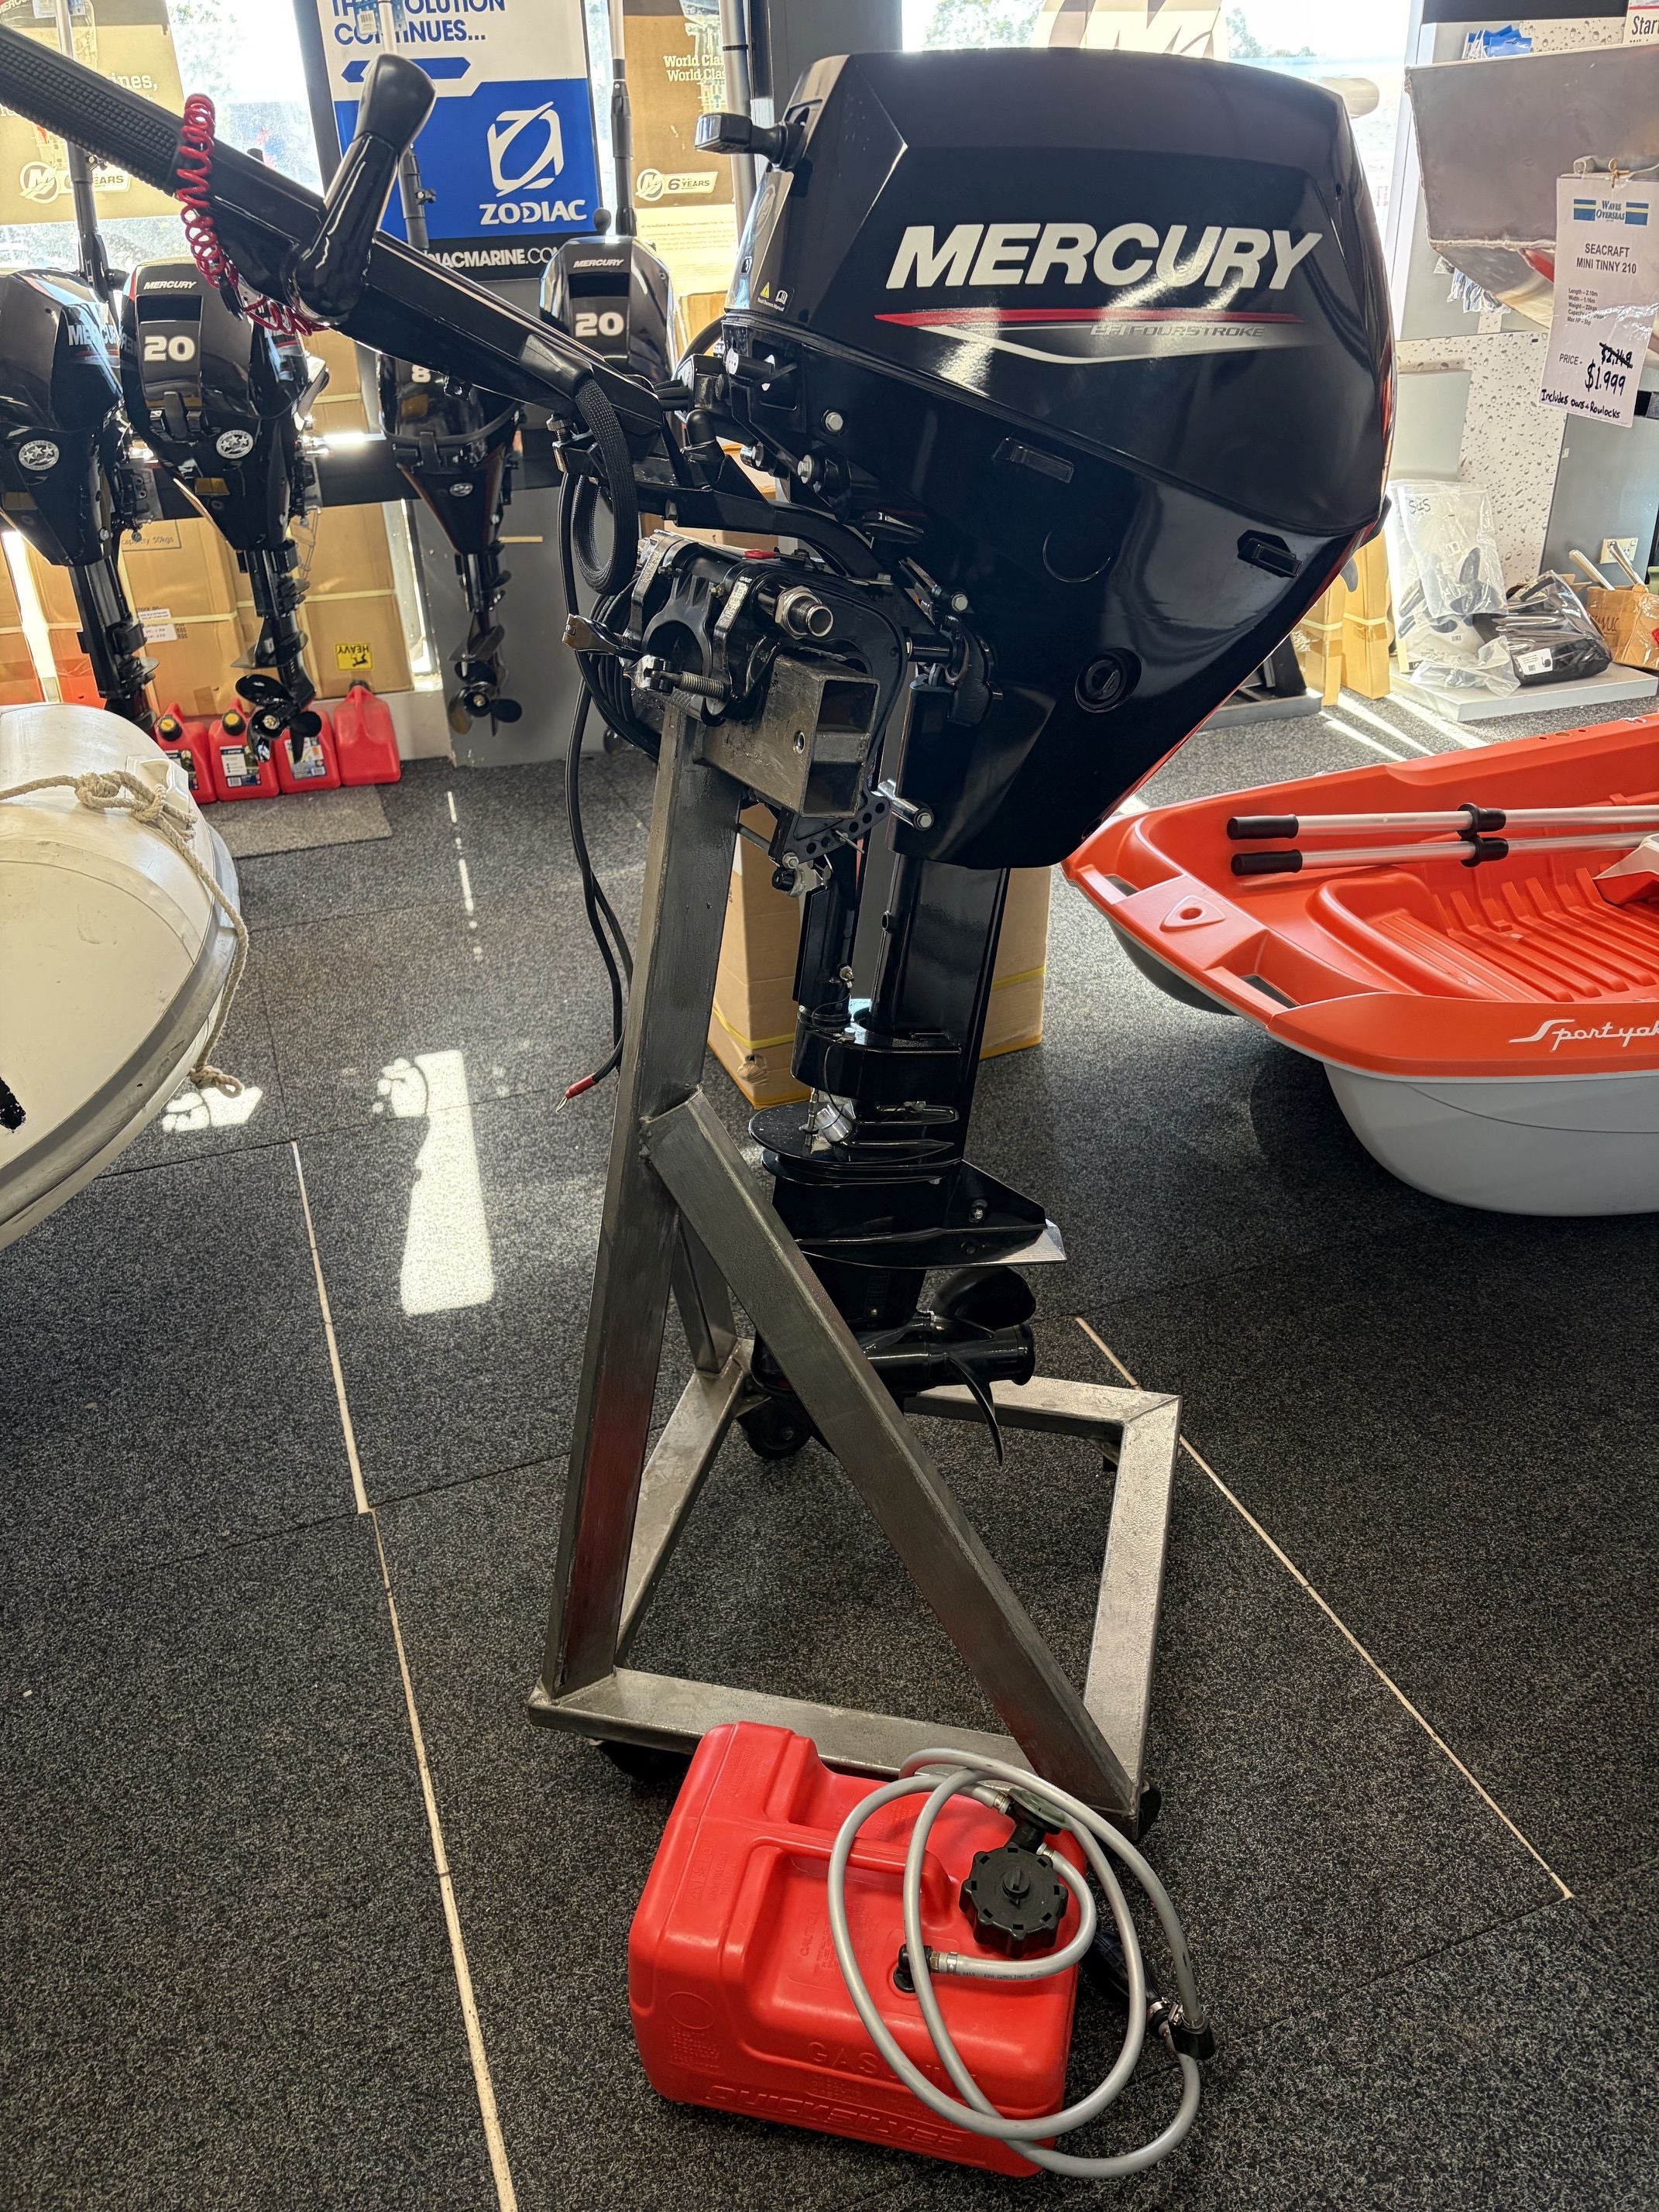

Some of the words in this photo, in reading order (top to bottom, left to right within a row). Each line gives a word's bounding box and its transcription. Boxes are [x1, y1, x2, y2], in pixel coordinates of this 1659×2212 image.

[1632, 15, 1659, 35] Star
[663, 55, 699, 67] World
[108, 71, 158, 91] ines,
[667, 70, 701, 81] World
[93, 175, 124, 184] EARS
[668, 178, 681, 191] 6
[479, 199, 587, 225] ZODIAC
[885, 222, 1323, 290] MERCURY
[1585, 242, 1630, 258] SEACRAFT
[573, 259, 625, 268] MERCURY
[1576, 257, 1594, 270] MINI
[1595, 259, 1620, 272] TINNY
[1622, 262, 1637, 274] 210
[143, 280, 197, 290] MERCURY
[575, 312, 624, 338] 20
[143, 335, 196, 362] 20
[1559, 353, 1579, 365] PRICE
[1541, 389, 1569, 405] Includes
[338, 644, 369, 654] HEAVY
